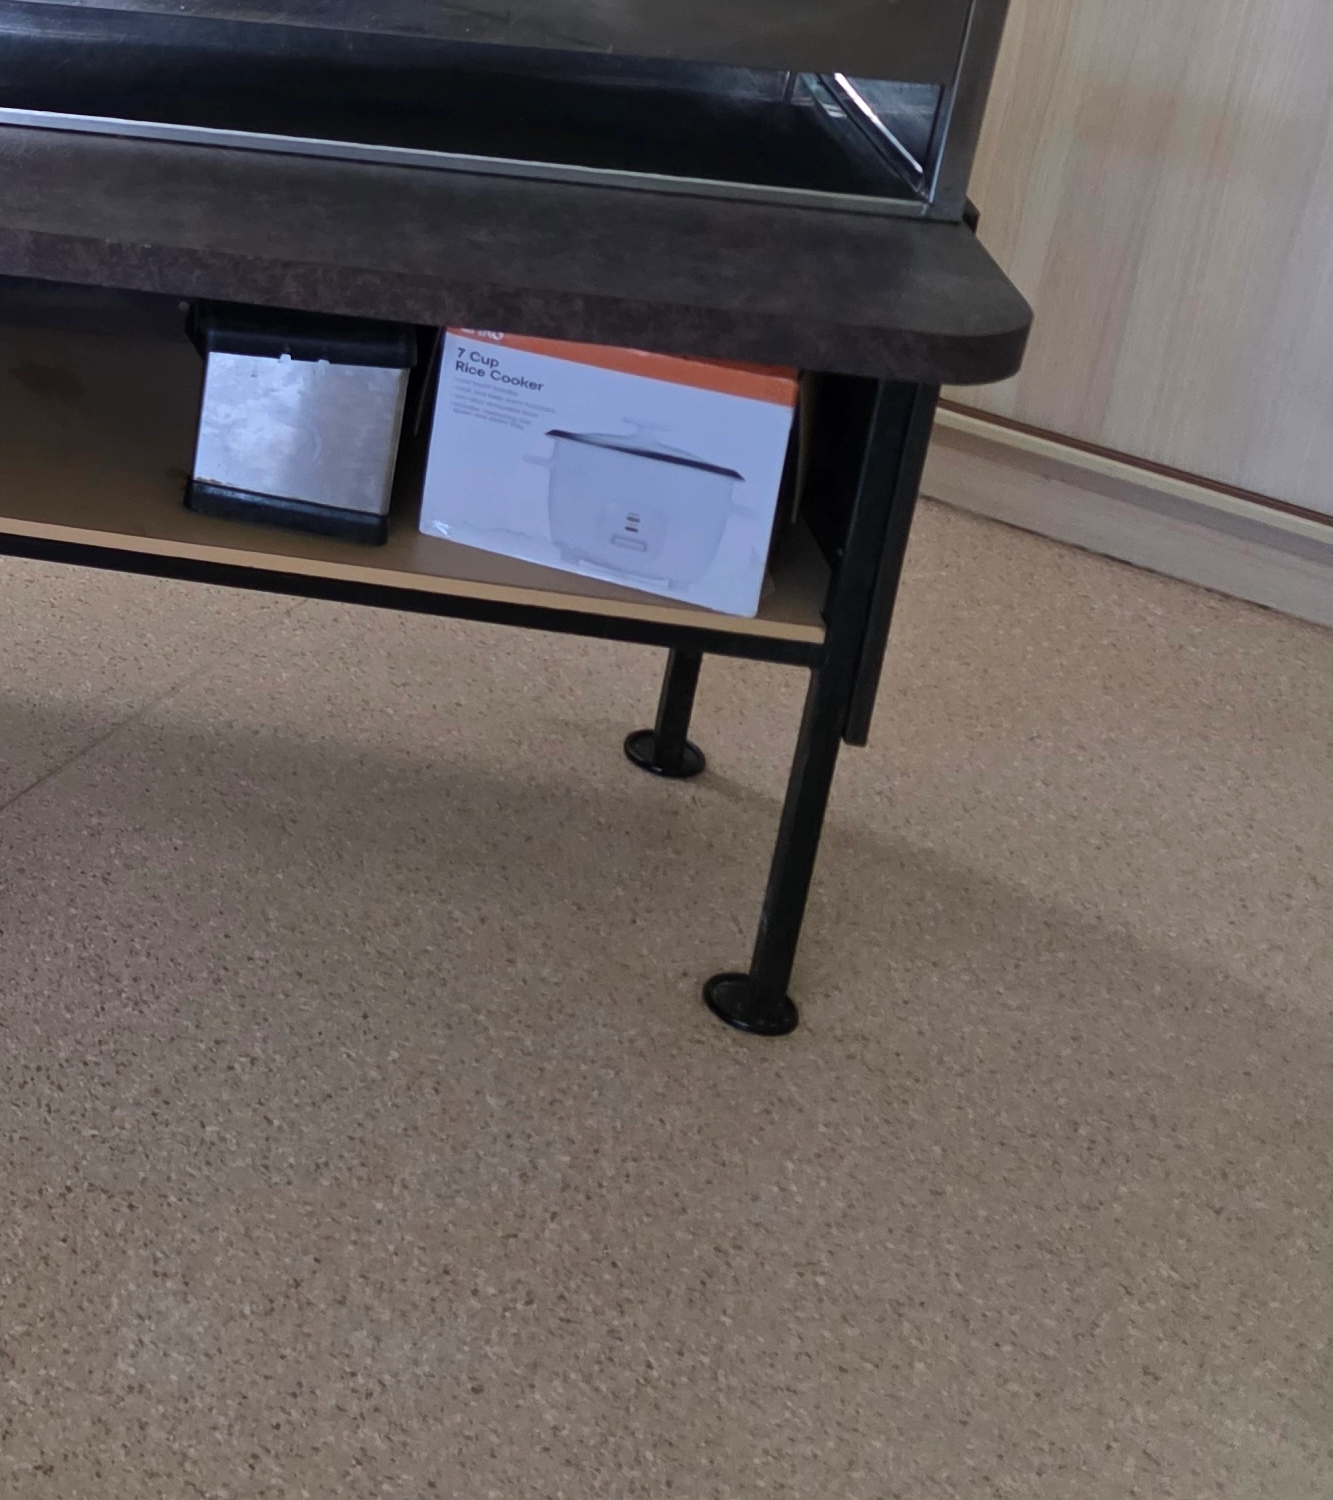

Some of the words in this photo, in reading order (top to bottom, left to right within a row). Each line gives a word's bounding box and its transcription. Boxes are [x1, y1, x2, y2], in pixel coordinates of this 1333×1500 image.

[457, 346, 466, 358] 7
[469, 351, 500, 368] Cup
[455, 360, 486, 377] Rice
[490, 369, 545, 391] Cooker
